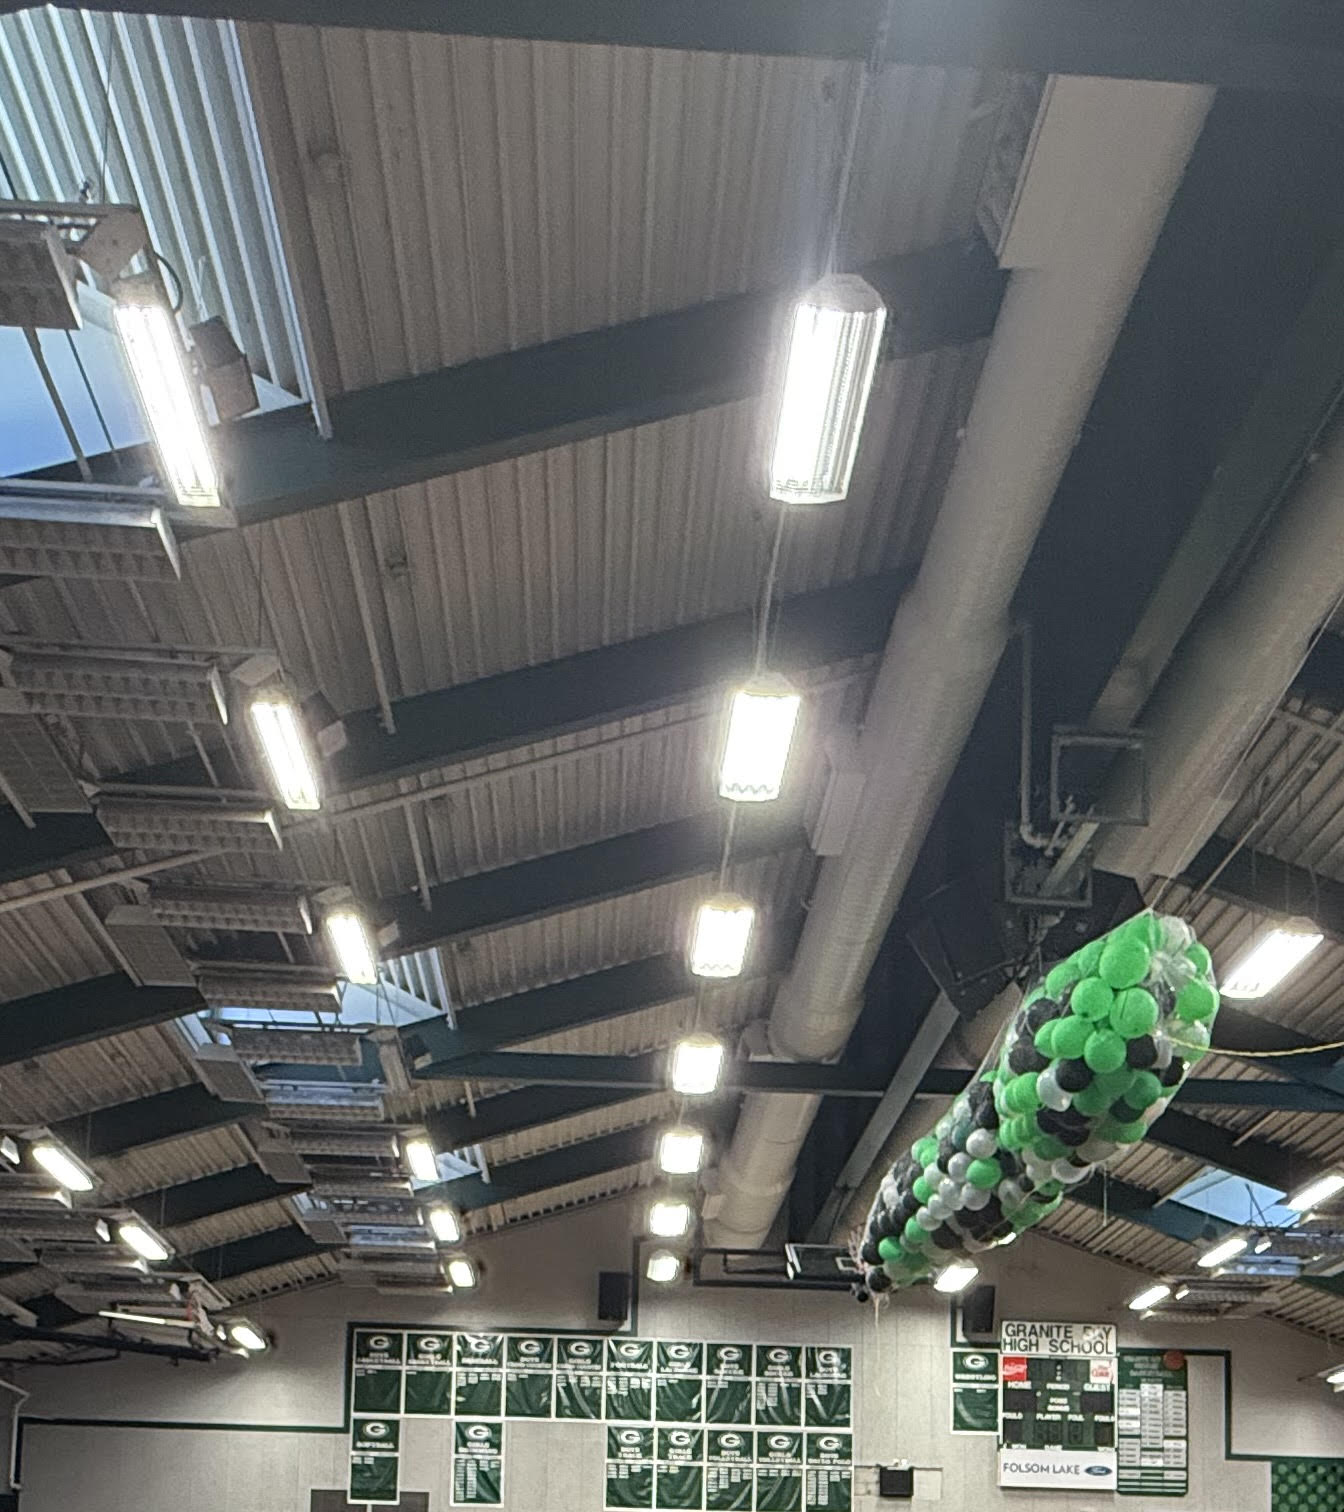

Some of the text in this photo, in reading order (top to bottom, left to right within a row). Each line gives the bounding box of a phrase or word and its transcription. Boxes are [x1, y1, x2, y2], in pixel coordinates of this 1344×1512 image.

[1005, 1323, 1113, 1341] GRANITE BAY
[1002, 1338, 1114, 1355] HIGH SCHOOL
[1003, 1463, 1050, 1474] FOLSOM
[1052, 1464, 1080, 1475] LAKE
